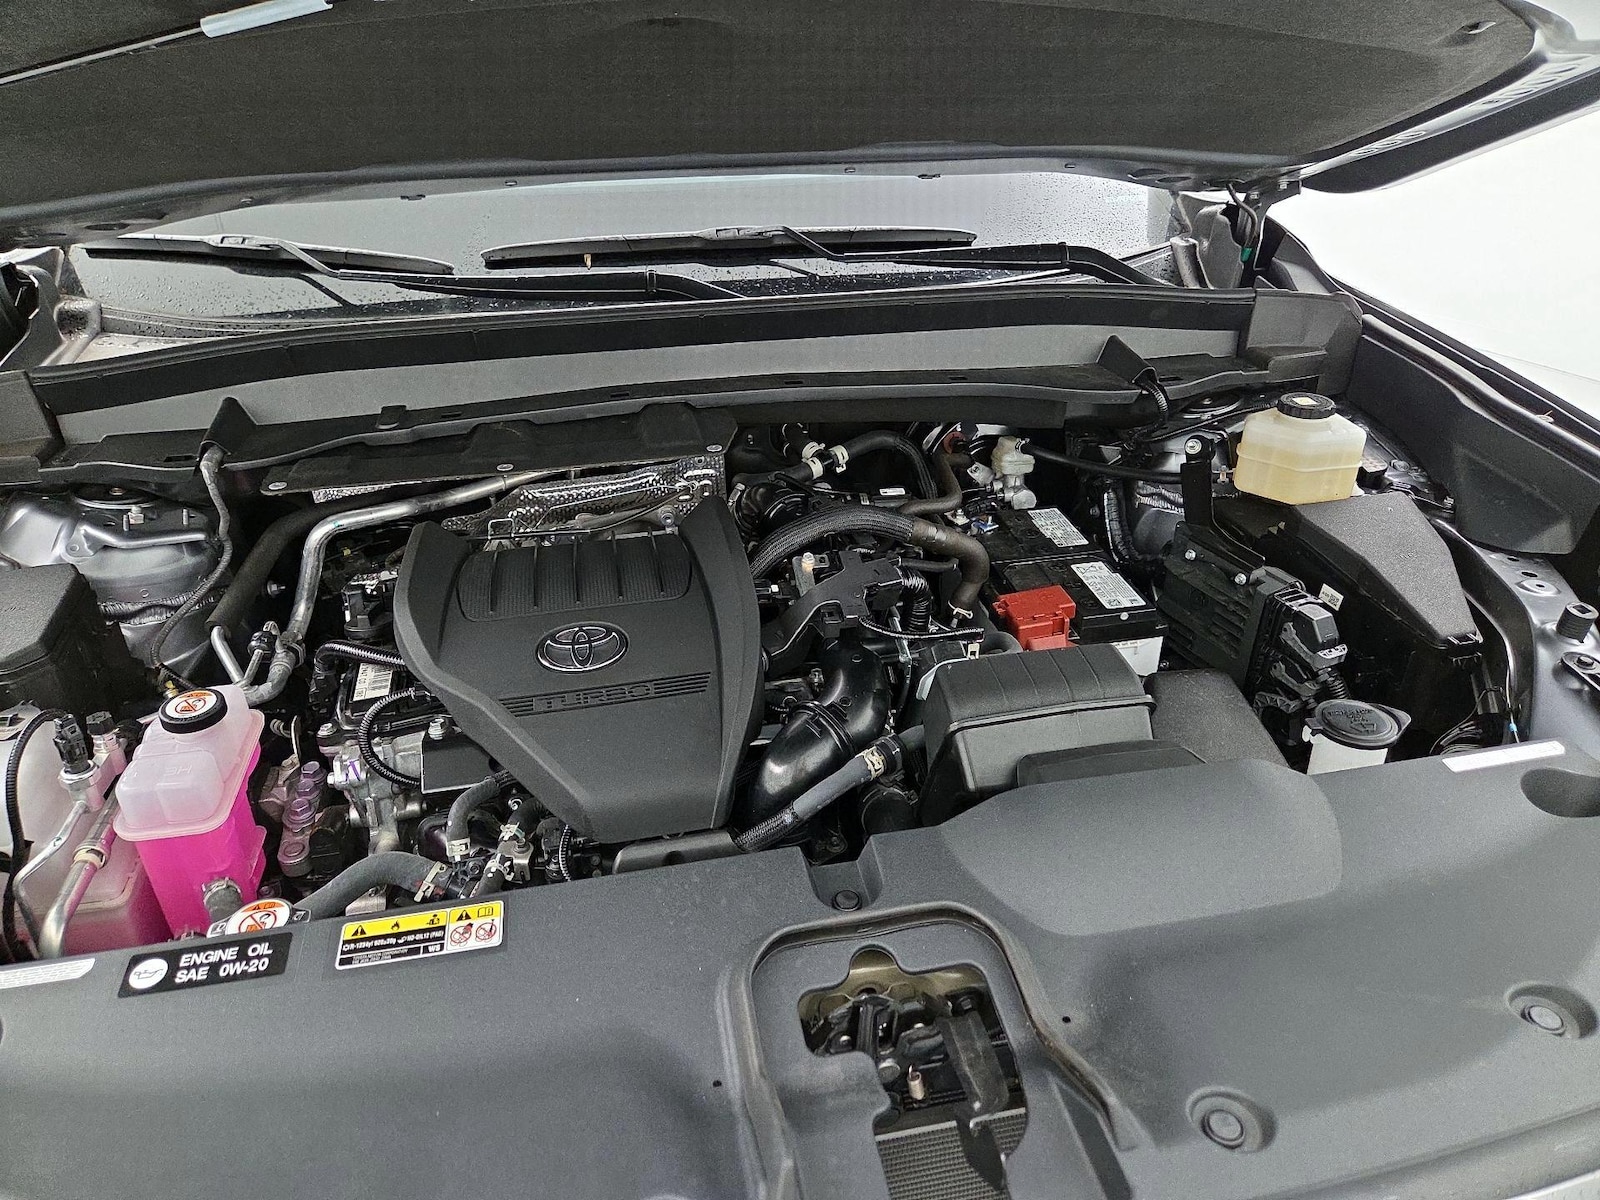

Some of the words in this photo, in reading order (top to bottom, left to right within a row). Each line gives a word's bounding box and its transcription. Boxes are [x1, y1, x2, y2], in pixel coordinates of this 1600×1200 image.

[533, 684, 651, 711] TURBO
[180, 946, 239, 968] ENGINE
[247, 942, 273, 957] OIL
[174, 966, 210, 984] SAE
[219, 957, 270, 978] 0W-20
